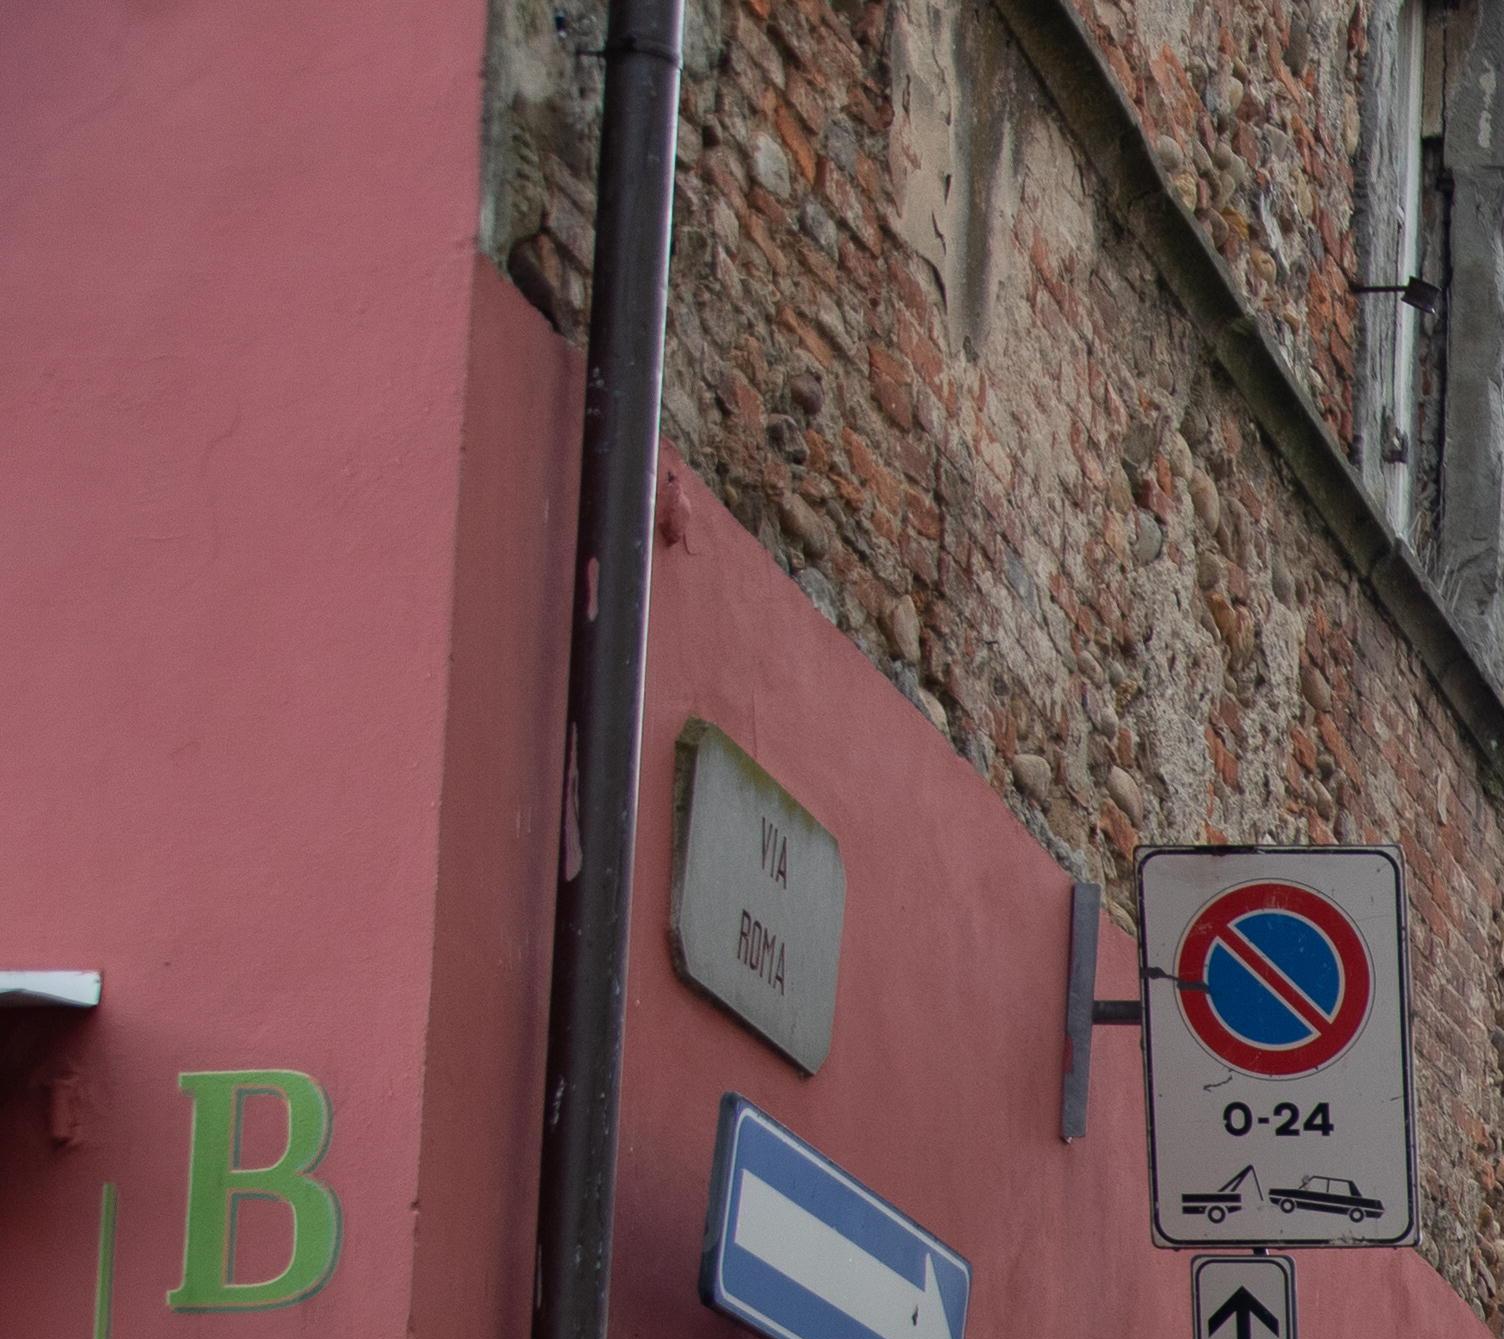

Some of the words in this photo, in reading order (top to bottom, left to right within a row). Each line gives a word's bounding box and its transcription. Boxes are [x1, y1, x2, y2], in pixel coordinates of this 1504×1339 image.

[761, 816, 788, 890] VIA
[737, 908, 786, 996] ROMA
[1223, 1101, 1334, 1136] 0-24
